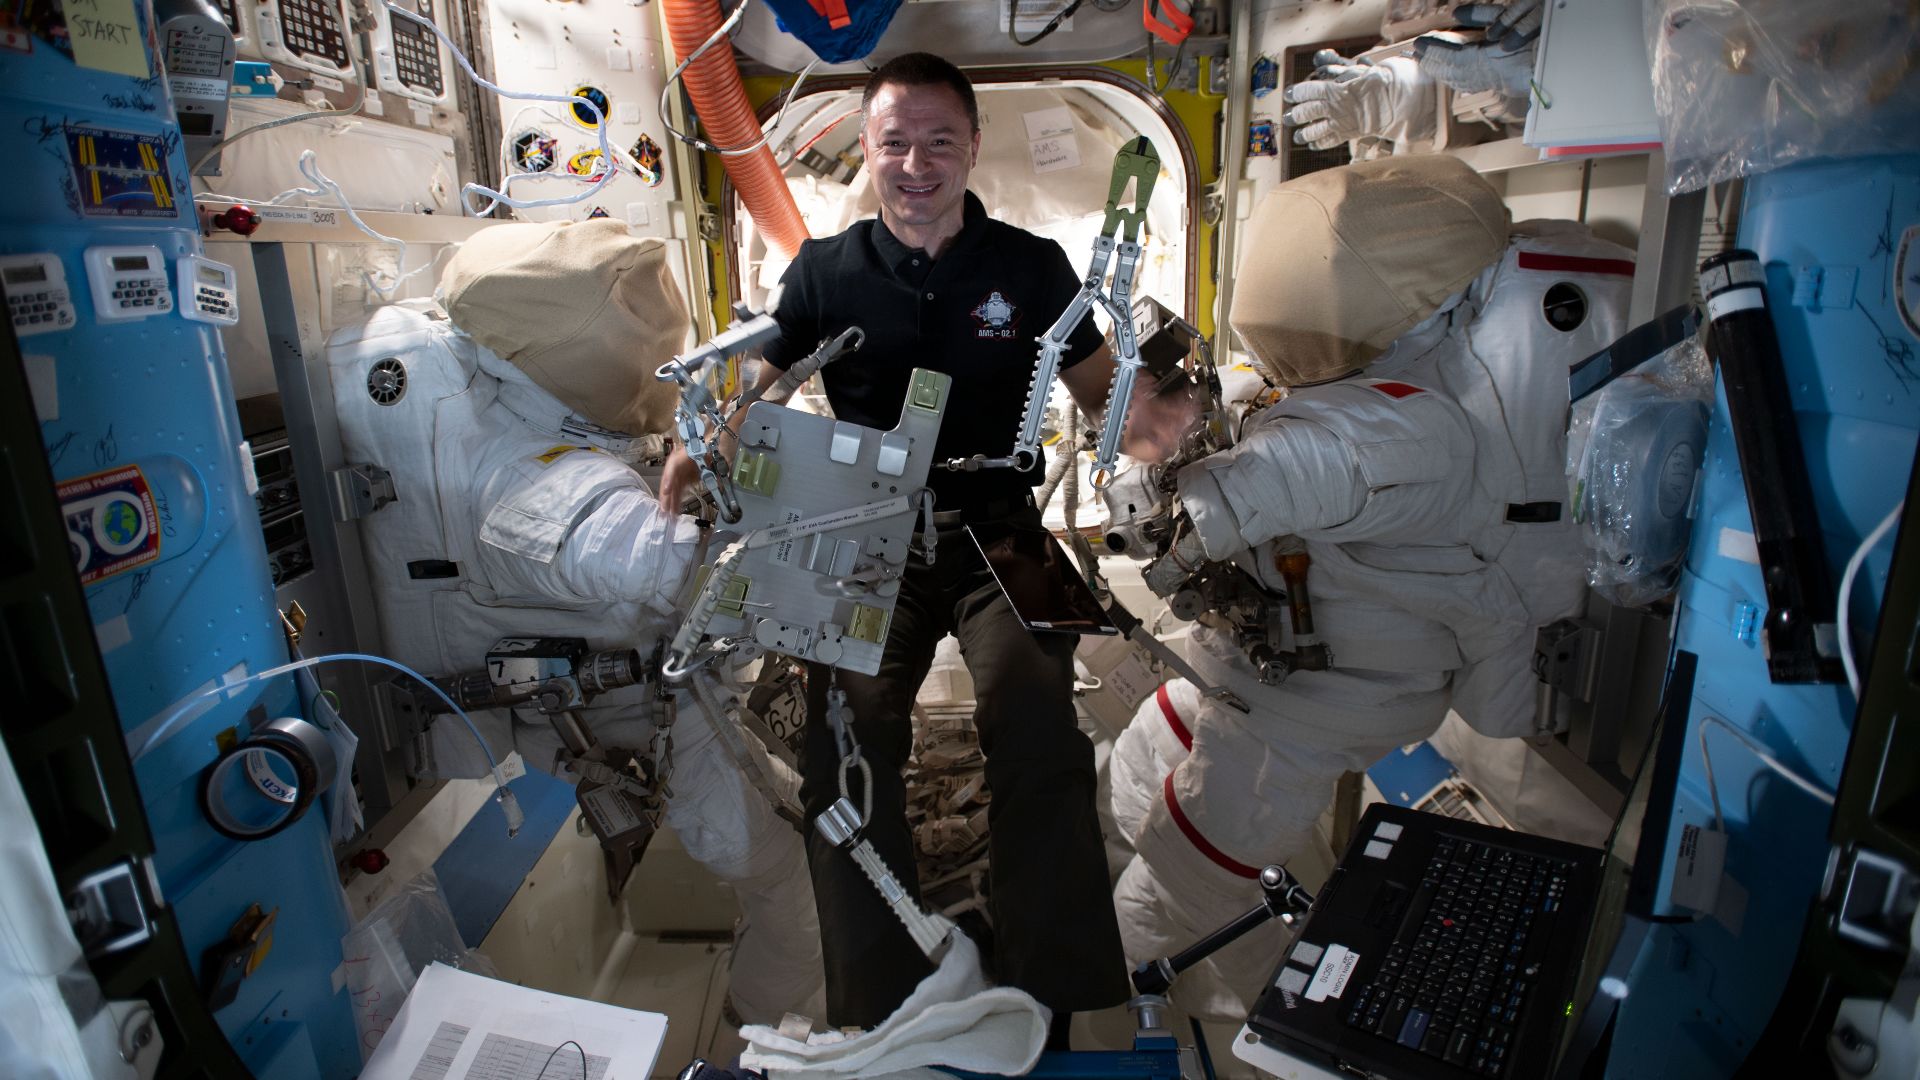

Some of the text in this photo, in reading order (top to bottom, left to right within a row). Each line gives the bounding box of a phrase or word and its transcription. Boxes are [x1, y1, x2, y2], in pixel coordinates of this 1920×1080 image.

[72, 14, 131, 45] START
[1034, 140, 1061, 156] AMS
[978, 329, 994, 337] AMS
[489, 660, 505, 678] 7
[1344, 955, 1356, 972] ADMIN
[1320, 963, 1334, 983] SSC10
[1333, 973, 1346, 994] LOGIN
